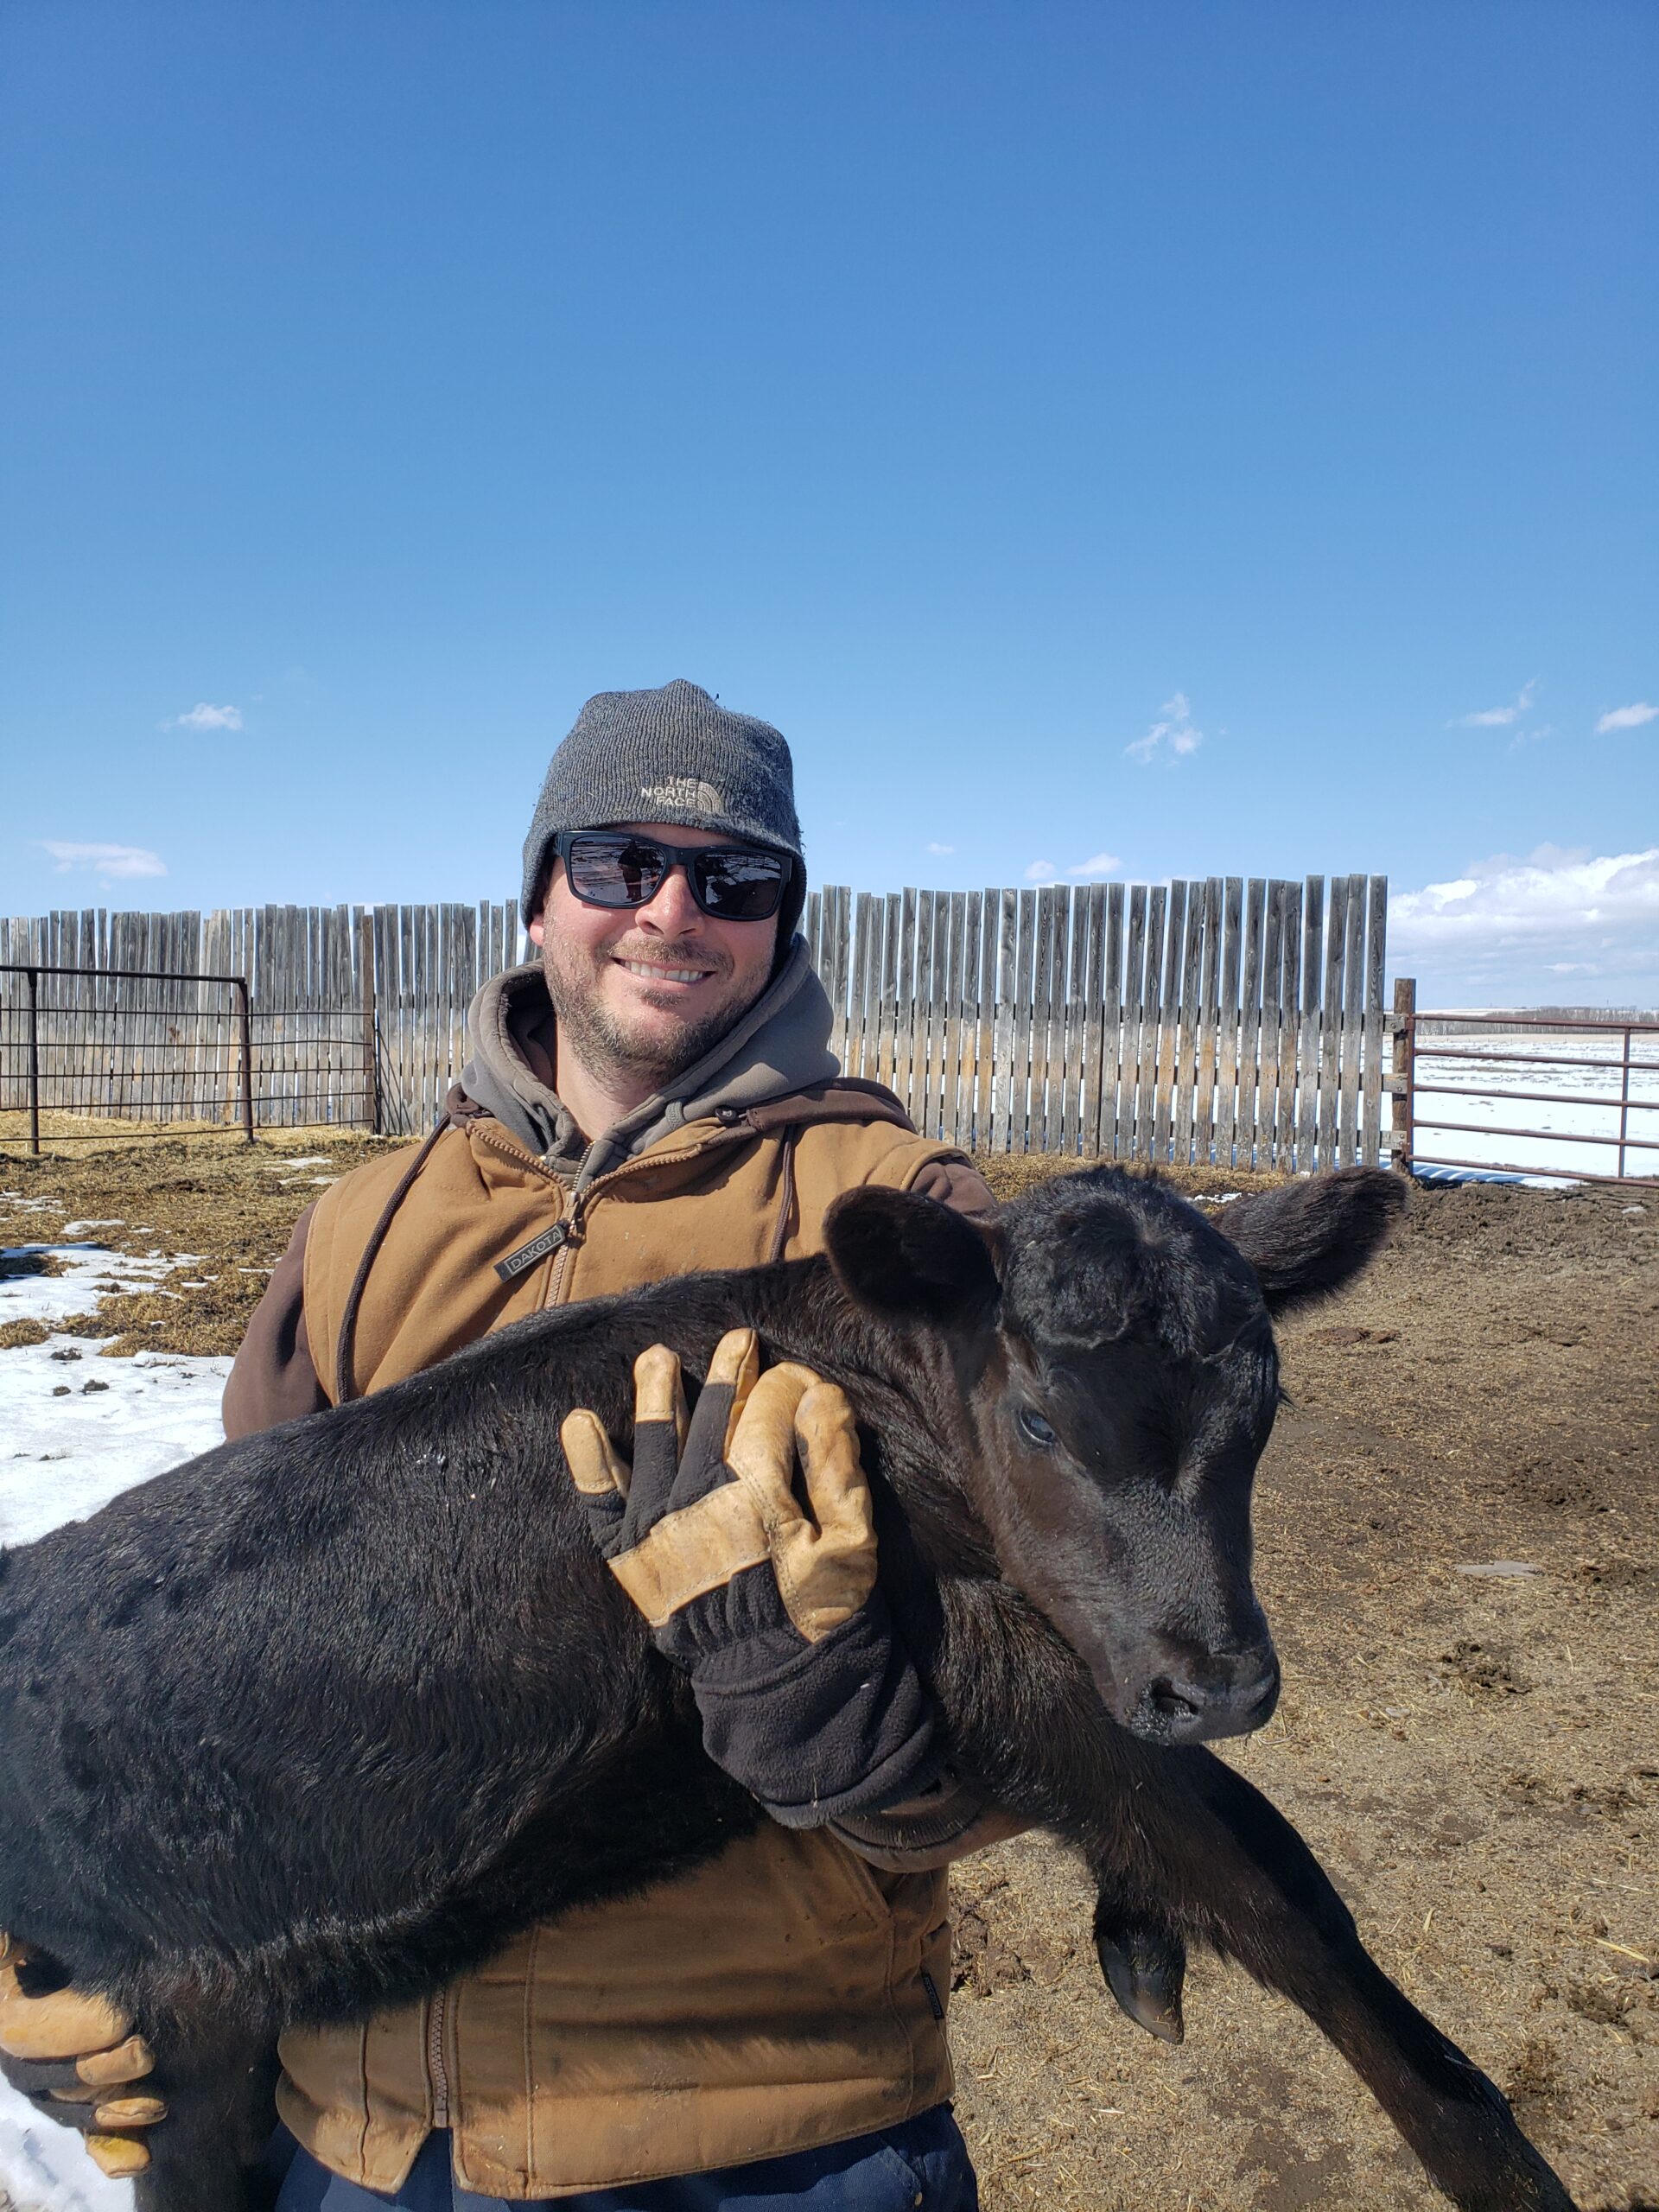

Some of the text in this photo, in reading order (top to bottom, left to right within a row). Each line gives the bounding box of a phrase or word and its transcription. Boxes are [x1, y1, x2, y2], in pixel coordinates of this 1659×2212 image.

[667, 776, 696, 788] THE
[640, 786, 696, 798] NORTH
[656, 796, 696, 808] FACE
[510, 1231, 560, 1269] DAKOTA
